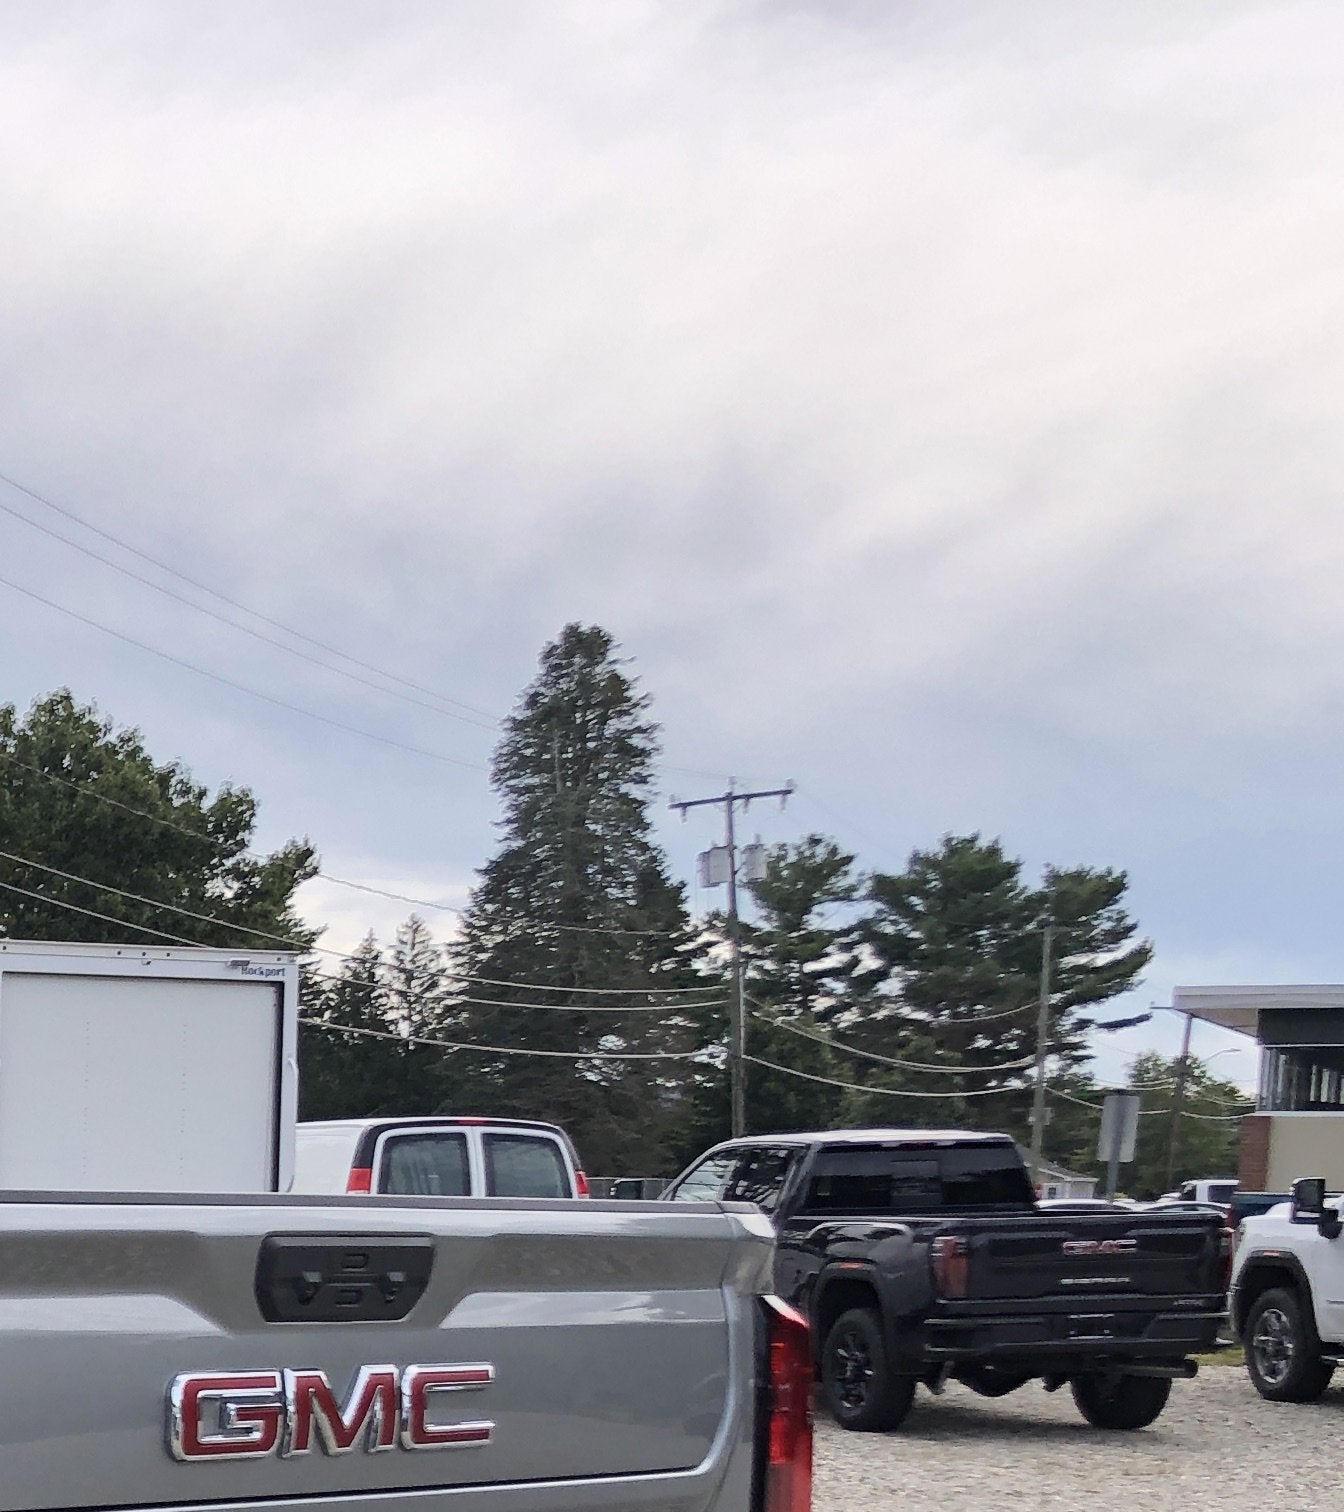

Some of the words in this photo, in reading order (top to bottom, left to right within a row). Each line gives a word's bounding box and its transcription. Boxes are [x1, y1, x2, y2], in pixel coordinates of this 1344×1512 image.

[241, 966, 286, 978] Rockport
[1062, 1239, 1137, 1255] GMC
[169, 1362, 496, 1461] GMC
